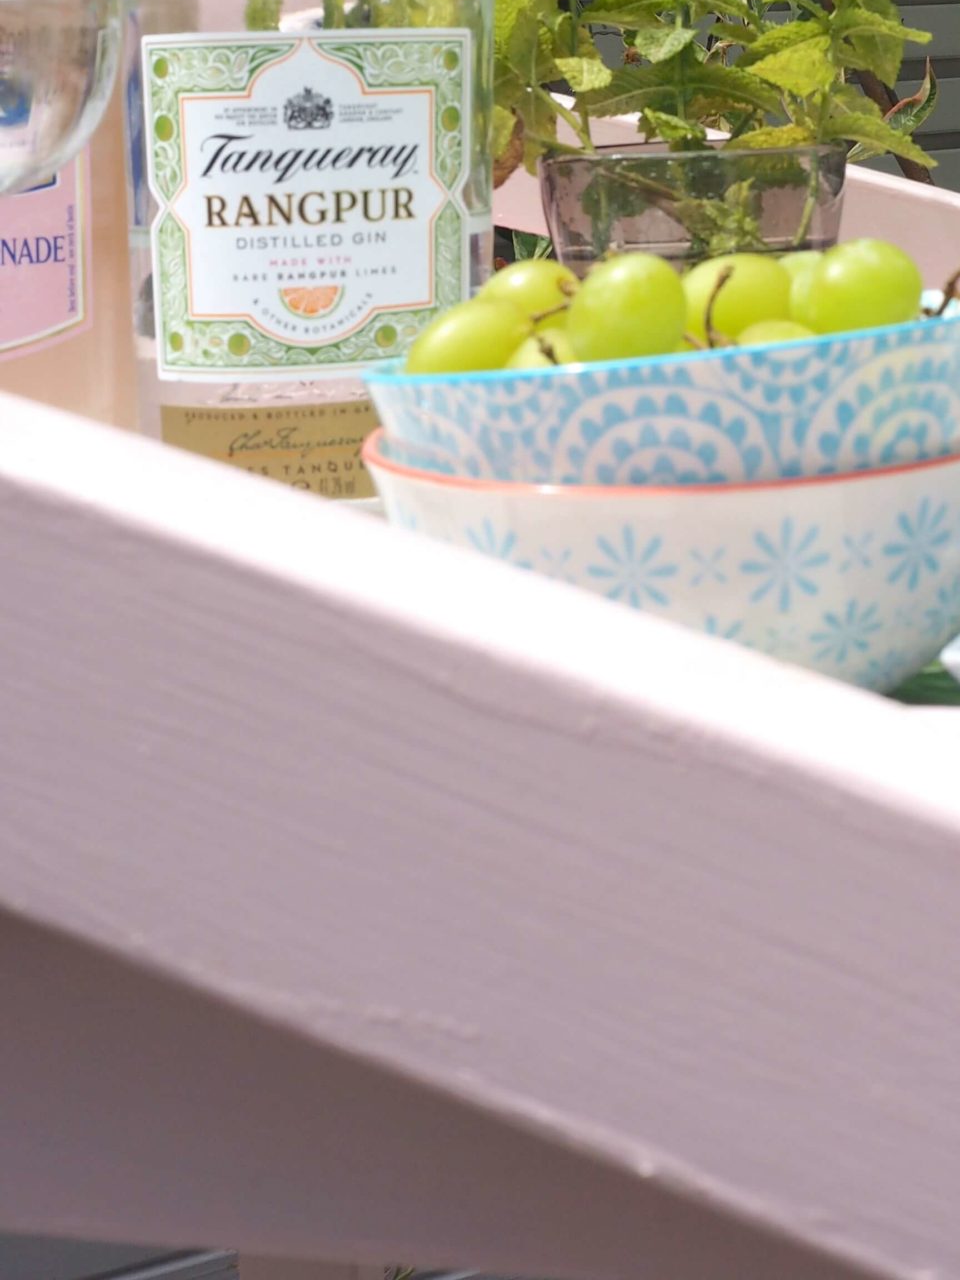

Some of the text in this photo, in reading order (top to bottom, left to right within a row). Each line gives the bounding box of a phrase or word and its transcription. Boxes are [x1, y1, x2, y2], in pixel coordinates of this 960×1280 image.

[200, 134, 420, 184] Tanqueray
[204, 187, 416, 229] RANGPUR
[236, 231, 387, 251] DISTILLED GIN
[269, 255, 353, 268] MADE WITH
[277, 269, 347, 281] RANGPUR
